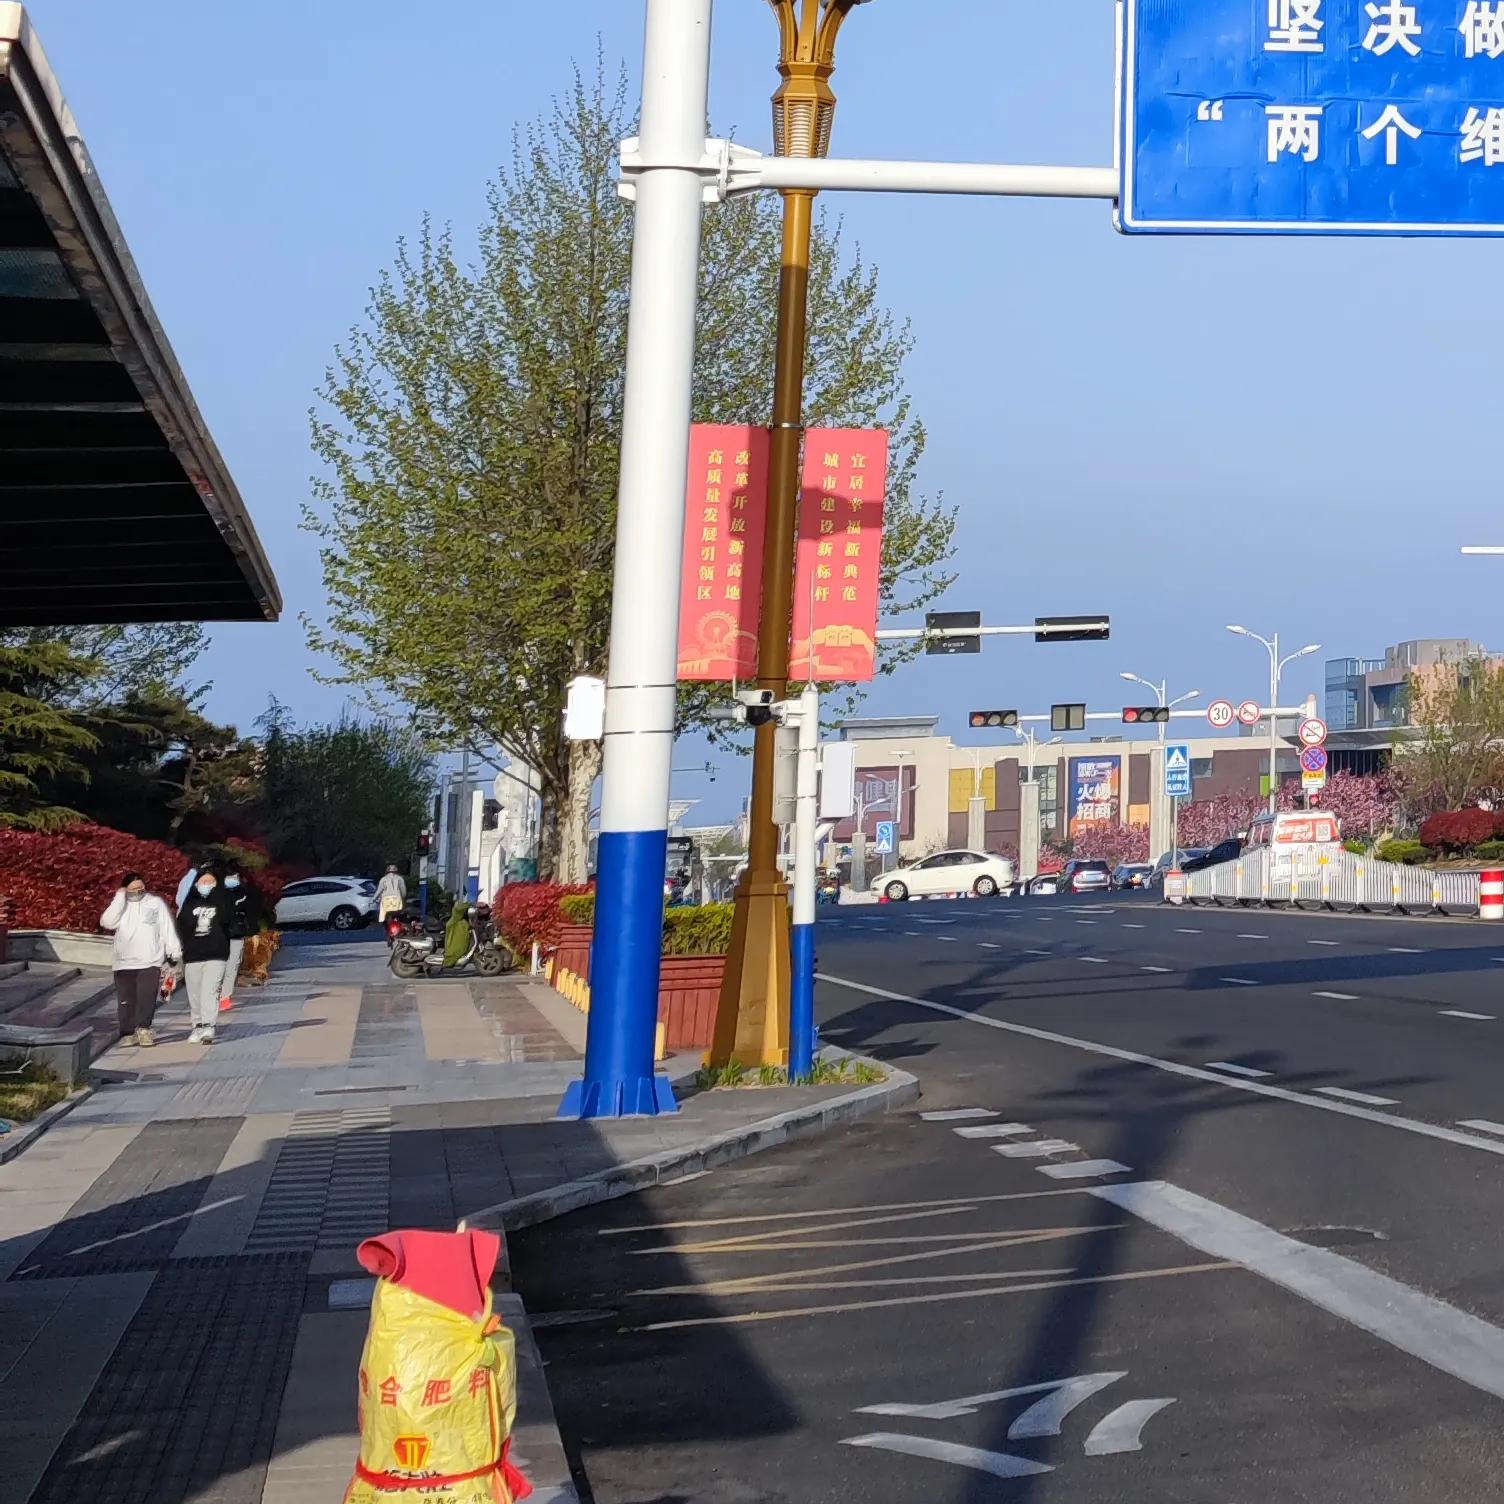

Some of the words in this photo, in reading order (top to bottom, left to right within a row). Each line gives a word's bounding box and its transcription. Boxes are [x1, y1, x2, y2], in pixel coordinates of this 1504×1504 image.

[696, 449, 724, 600] 高质量发展引领区
[724, 450, 751, 600] 改革开放新高地
[814, 453, 840, 601] 城市建设新标杆
[841, 453, 866, 601] 宜居幸福新典范
[1213, 707, 1228, 721] 30
[1076, 802, 1112, 820] 招商
